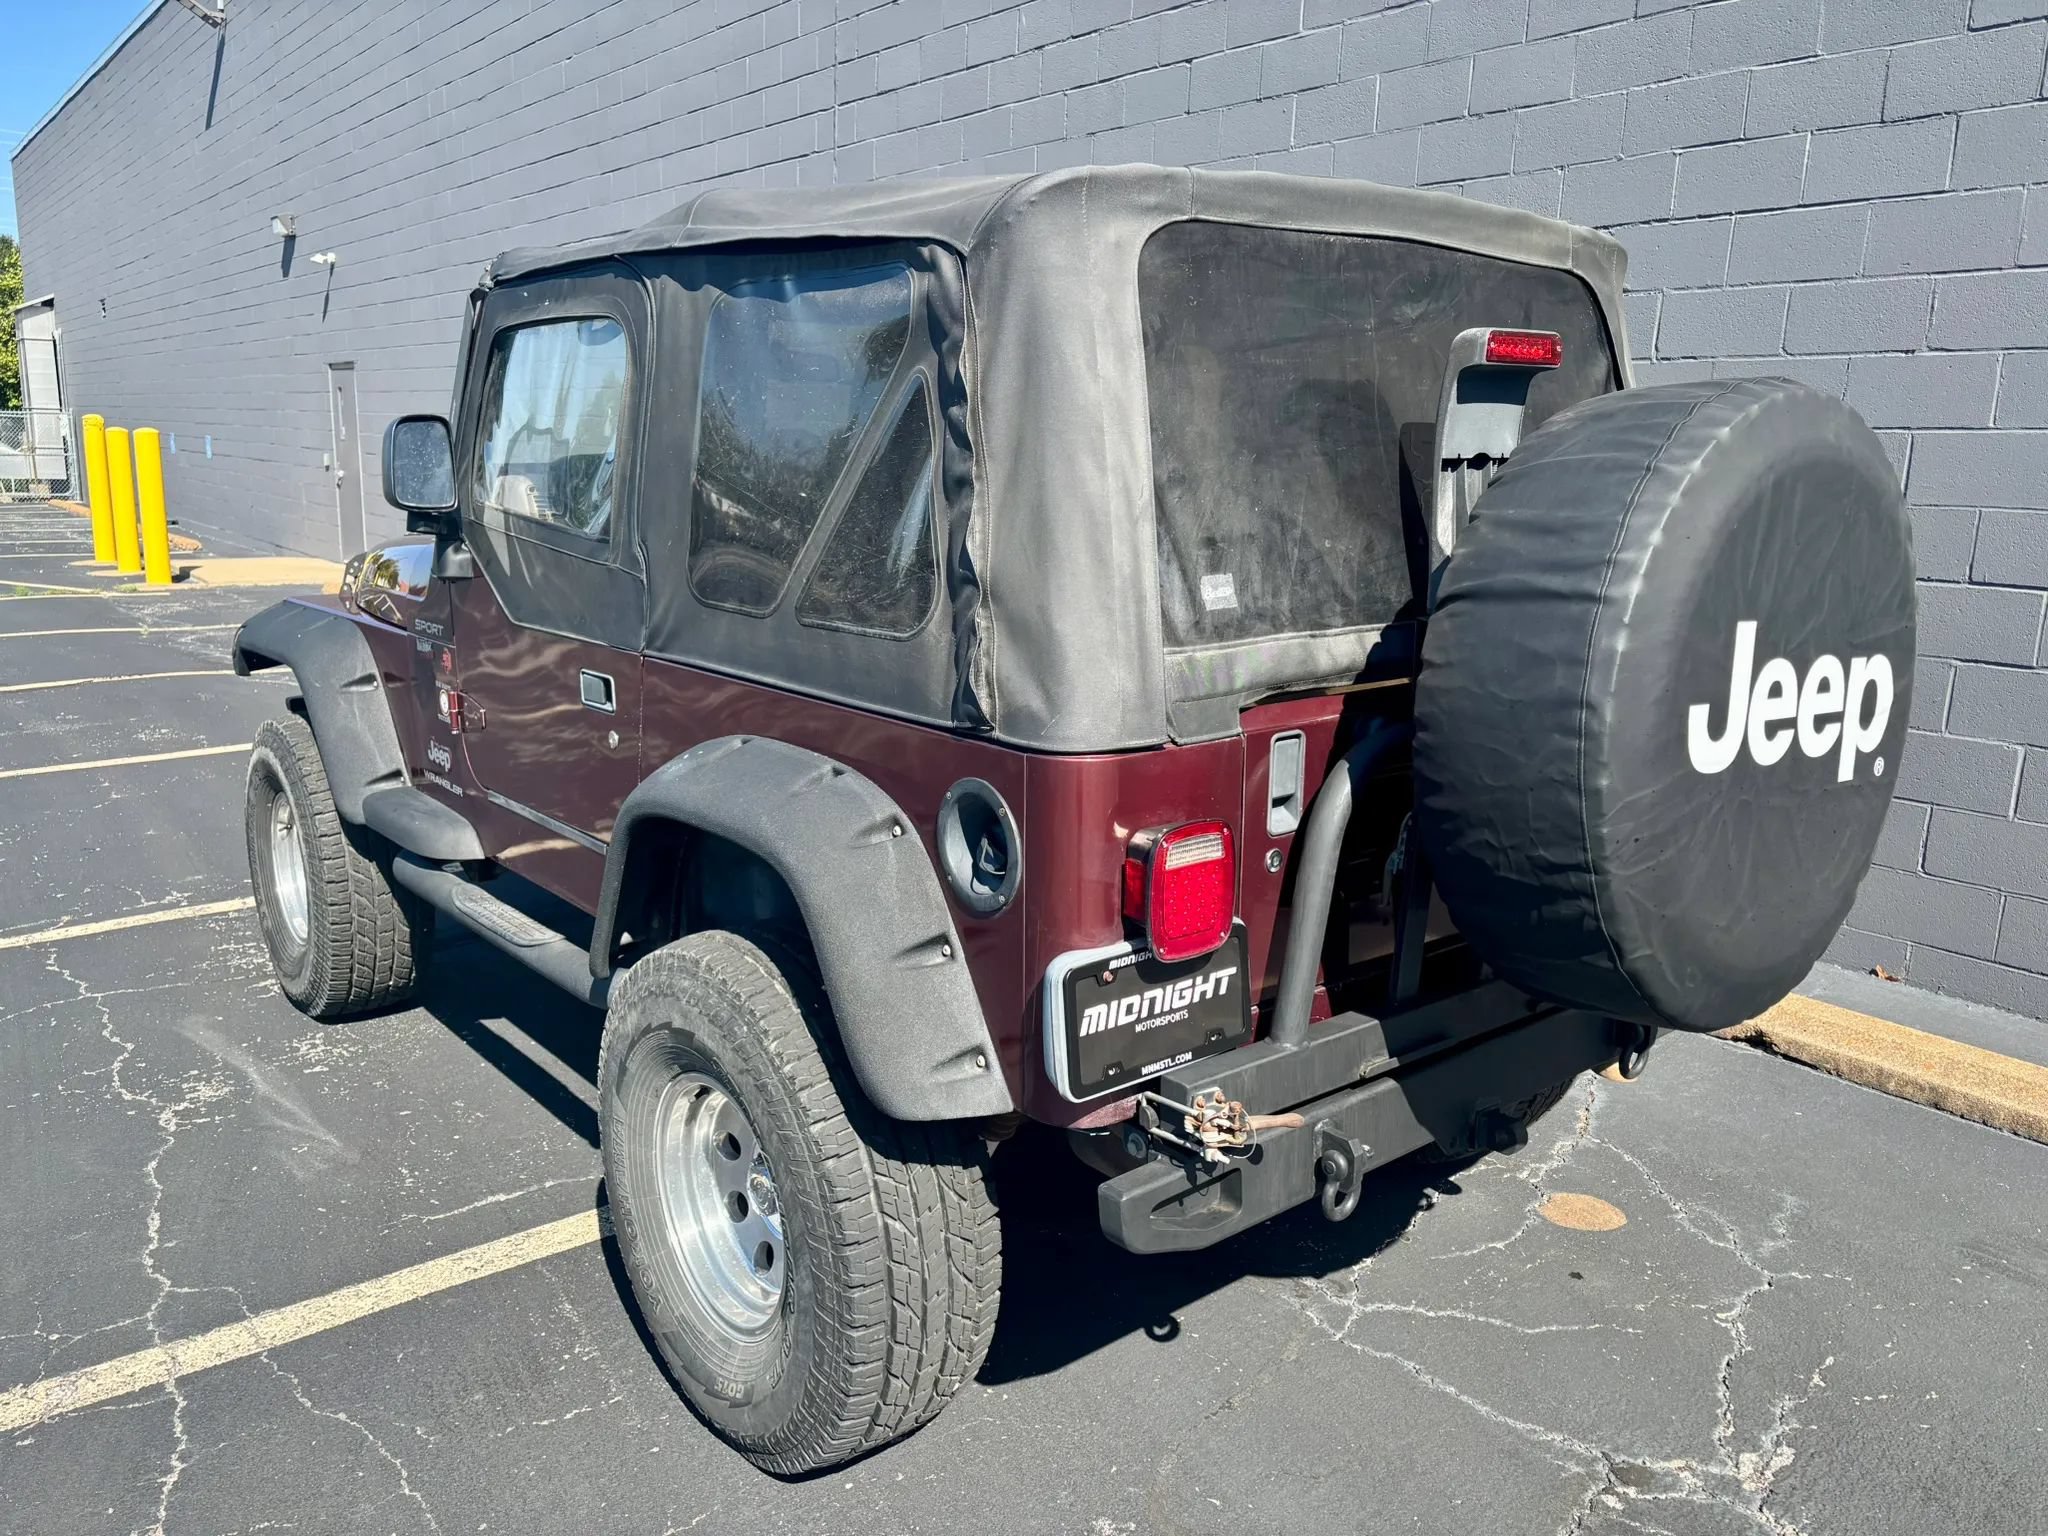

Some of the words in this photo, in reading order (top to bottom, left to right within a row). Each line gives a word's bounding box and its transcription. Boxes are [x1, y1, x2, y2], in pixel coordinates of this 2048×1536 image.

[414, 618, 444, 637] SPORT
[1688, 620, 1894, 783] Jeep
[428, 739, 451, 772] Jeep
[423, 769, 463, 797] WRANGLER
[1109, 951, 1152, 970] MIDNIGH
[1079, 966, 1237, 1037] MIDNIGHT
[1135, 1009, 1189, 1033] MOTORSPORTS
[1141, 1051, 1192, 1076] MNMSTL.COM
[612, 1116, 663, 1315] YOKOHAMA
